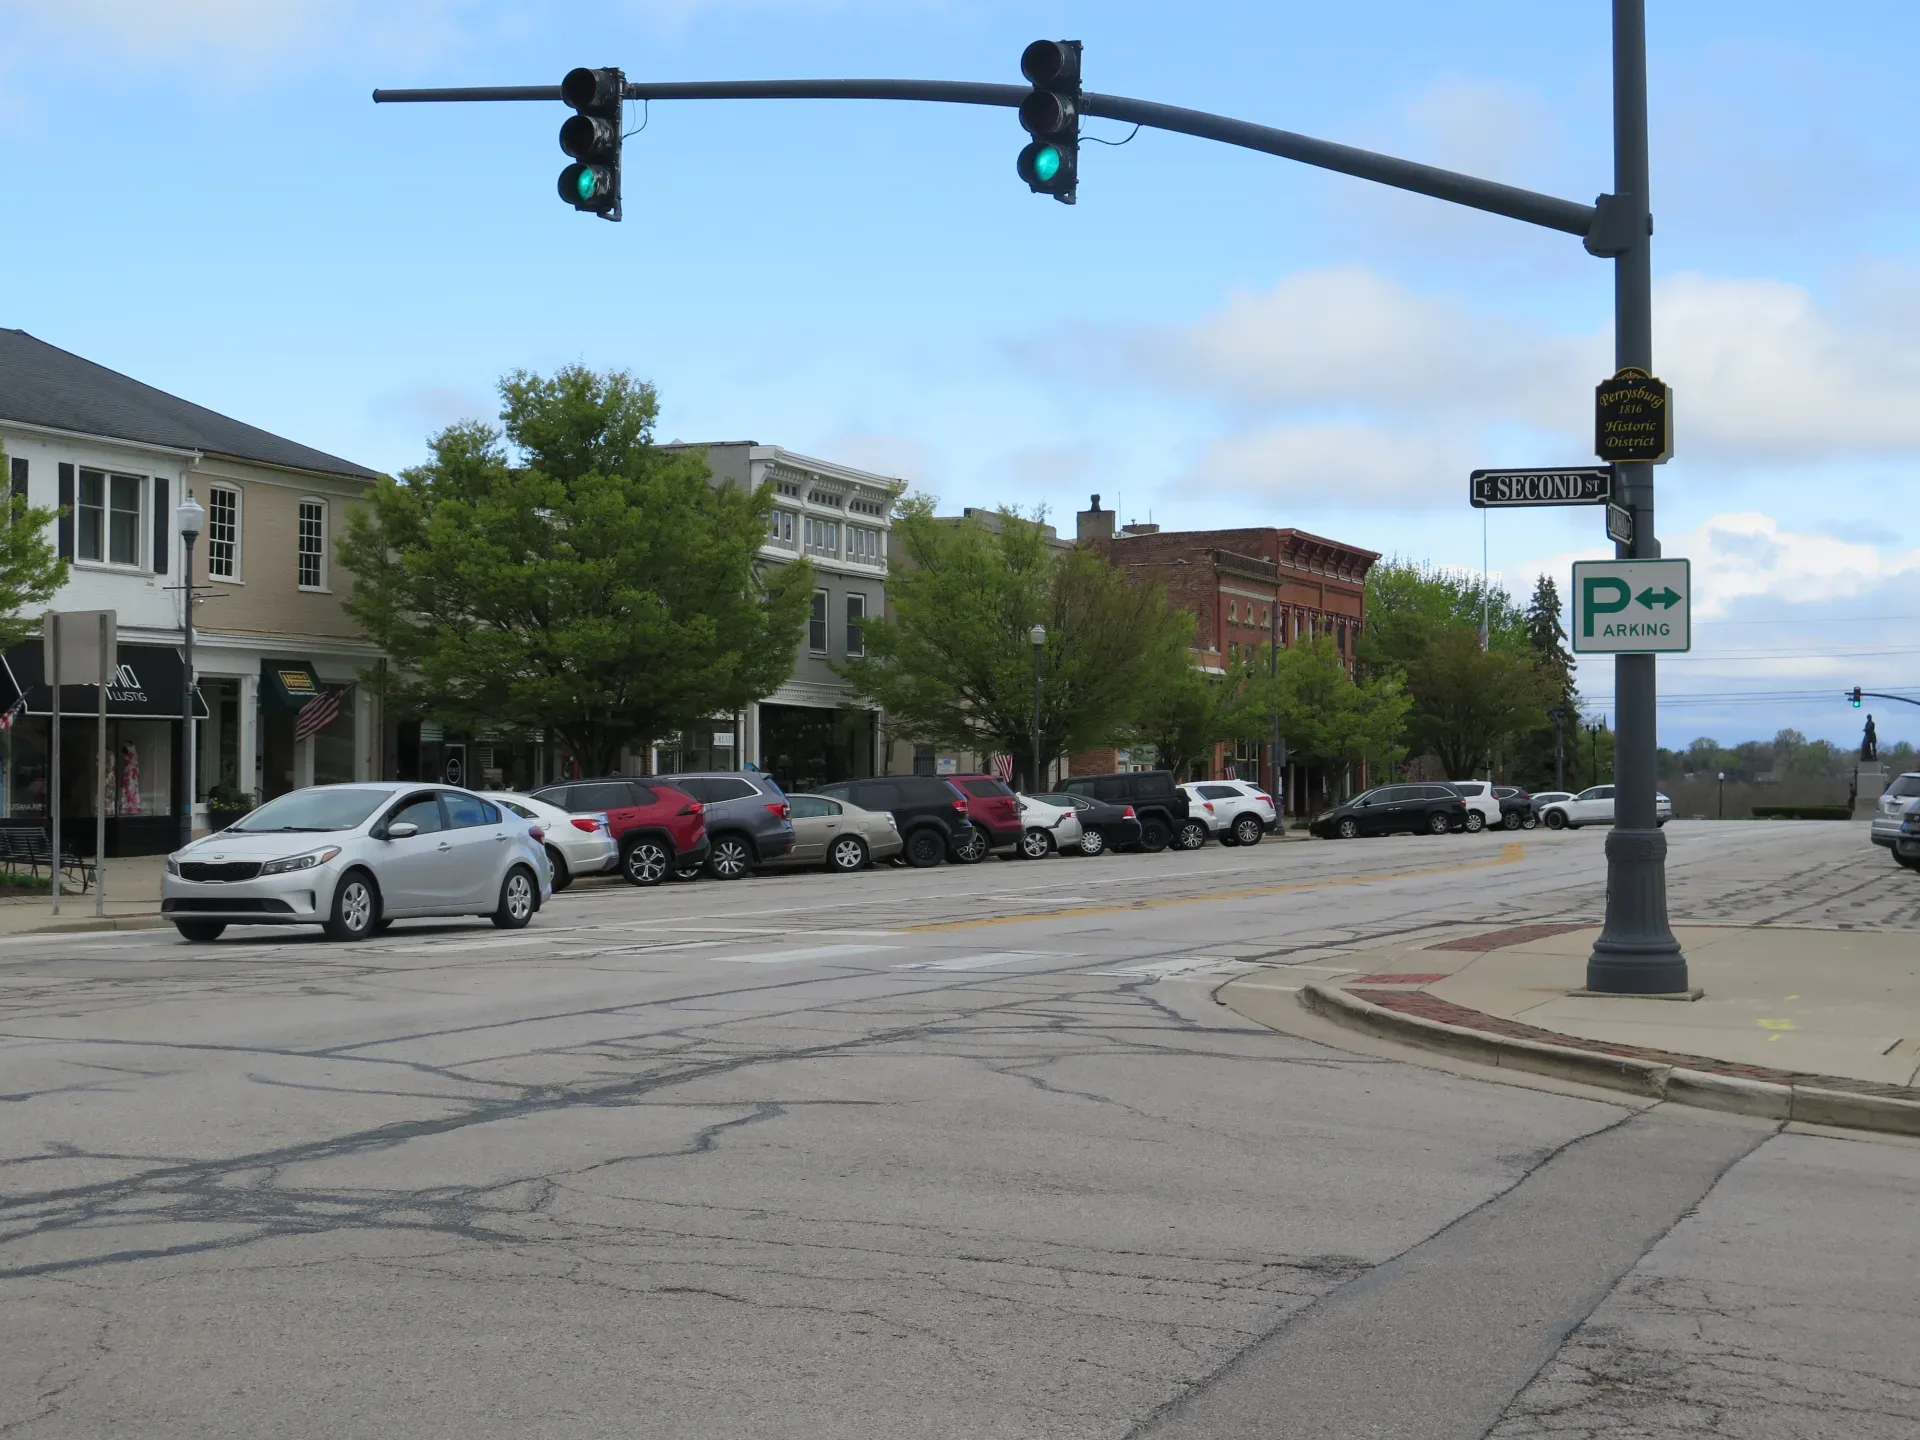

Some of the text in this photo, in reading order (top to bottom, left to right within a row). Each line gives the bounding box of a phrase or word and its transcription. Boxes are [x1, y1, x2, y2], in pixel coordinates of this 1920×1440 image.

[1600, 386, 1664, 408] Perrysburg
[1619, 404, 1642, 414] 1816
[1605, 420, 1656, 432] Historic
[1605, 435, 1655, 447] District
[1484, 475, 1600, 500] E SECOND ST
[112, 691, 147, 702] LUSTIG
